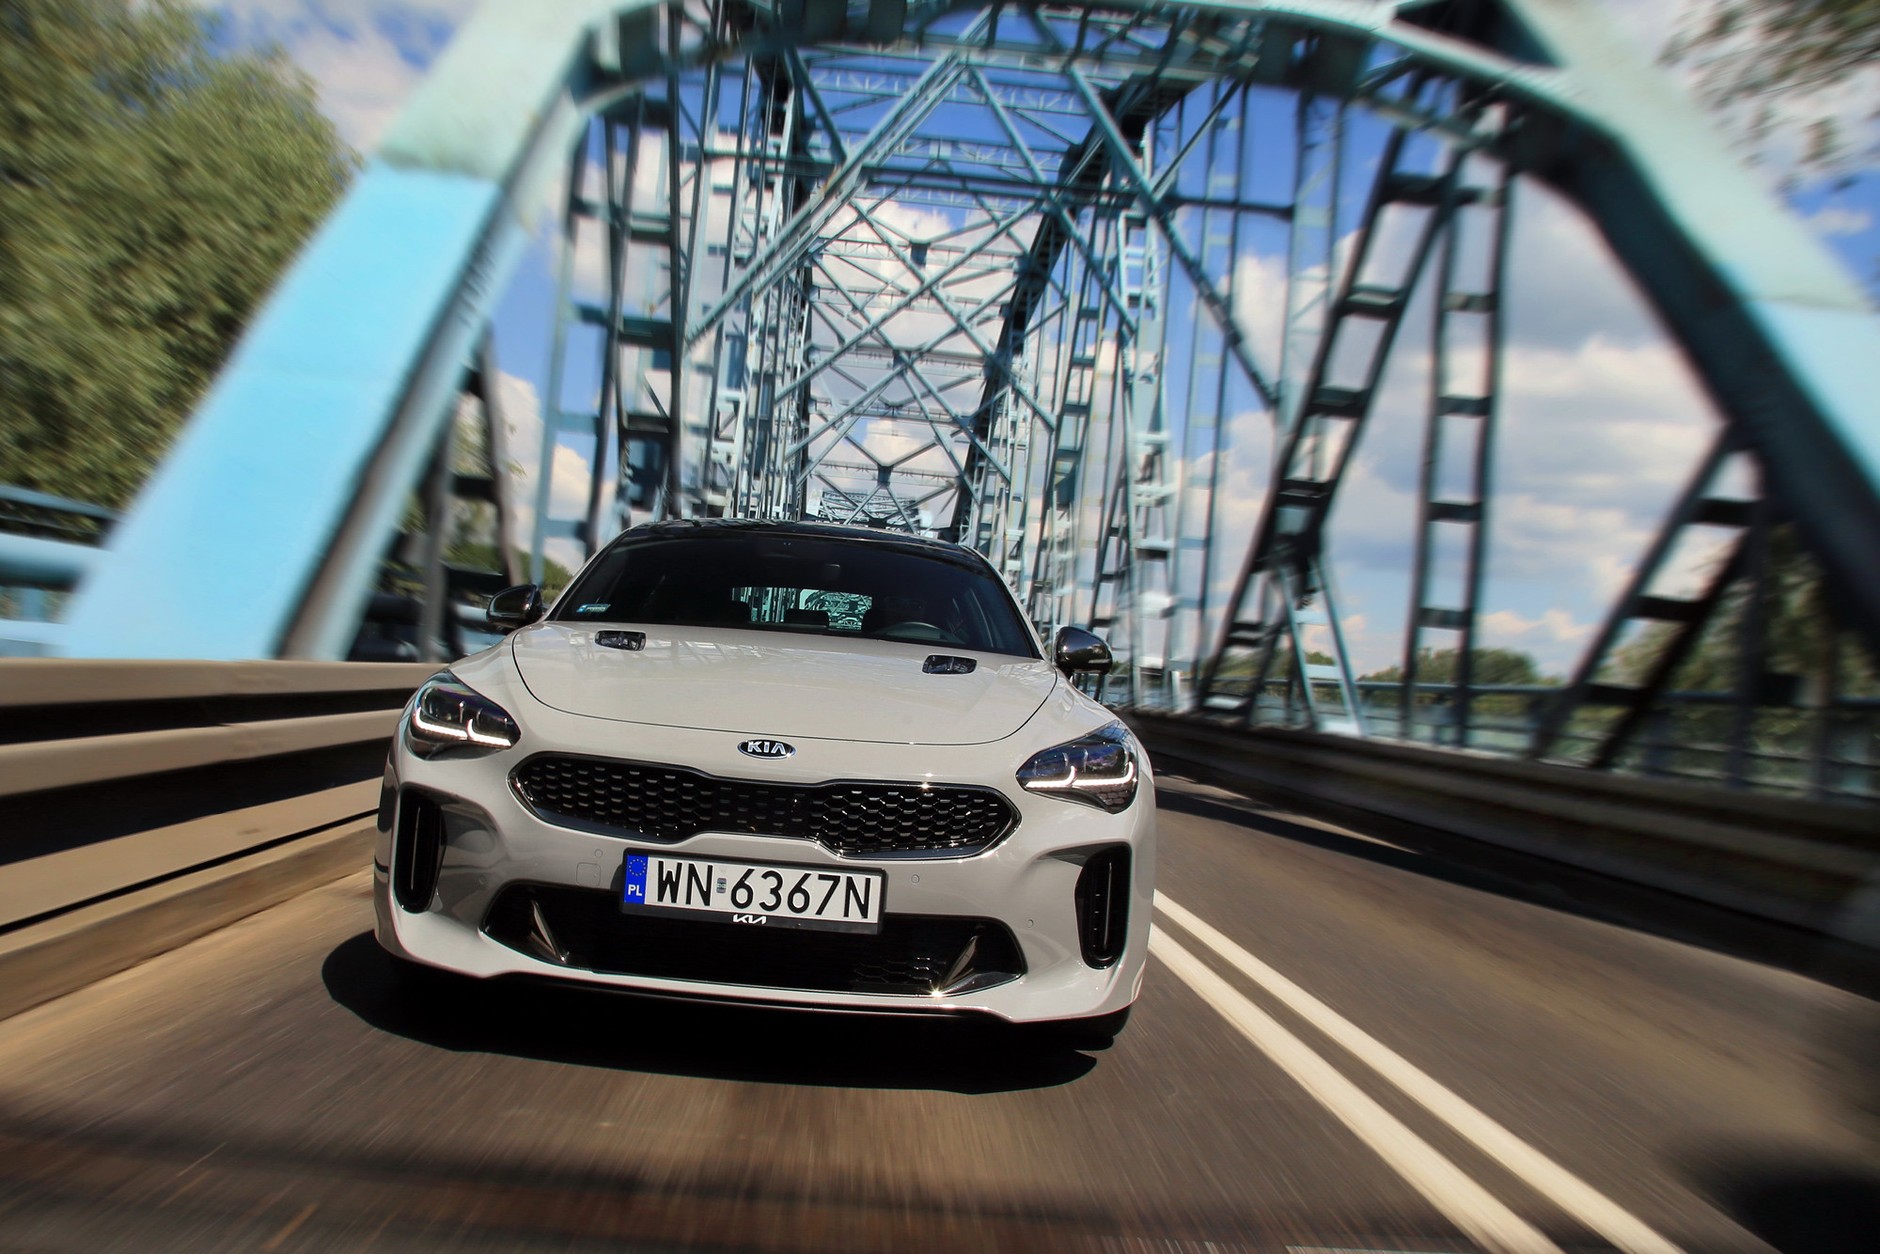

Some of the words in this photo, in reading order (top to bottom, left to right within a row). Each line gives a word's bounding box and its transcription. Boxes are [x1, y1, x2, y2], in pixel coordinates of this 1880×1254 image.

[747, 741, 787, 755] KIA
[627, 884, 643, 896] PL
[657, 860, 714, 906] WN
[730, 868, 871, 919] 6367N
